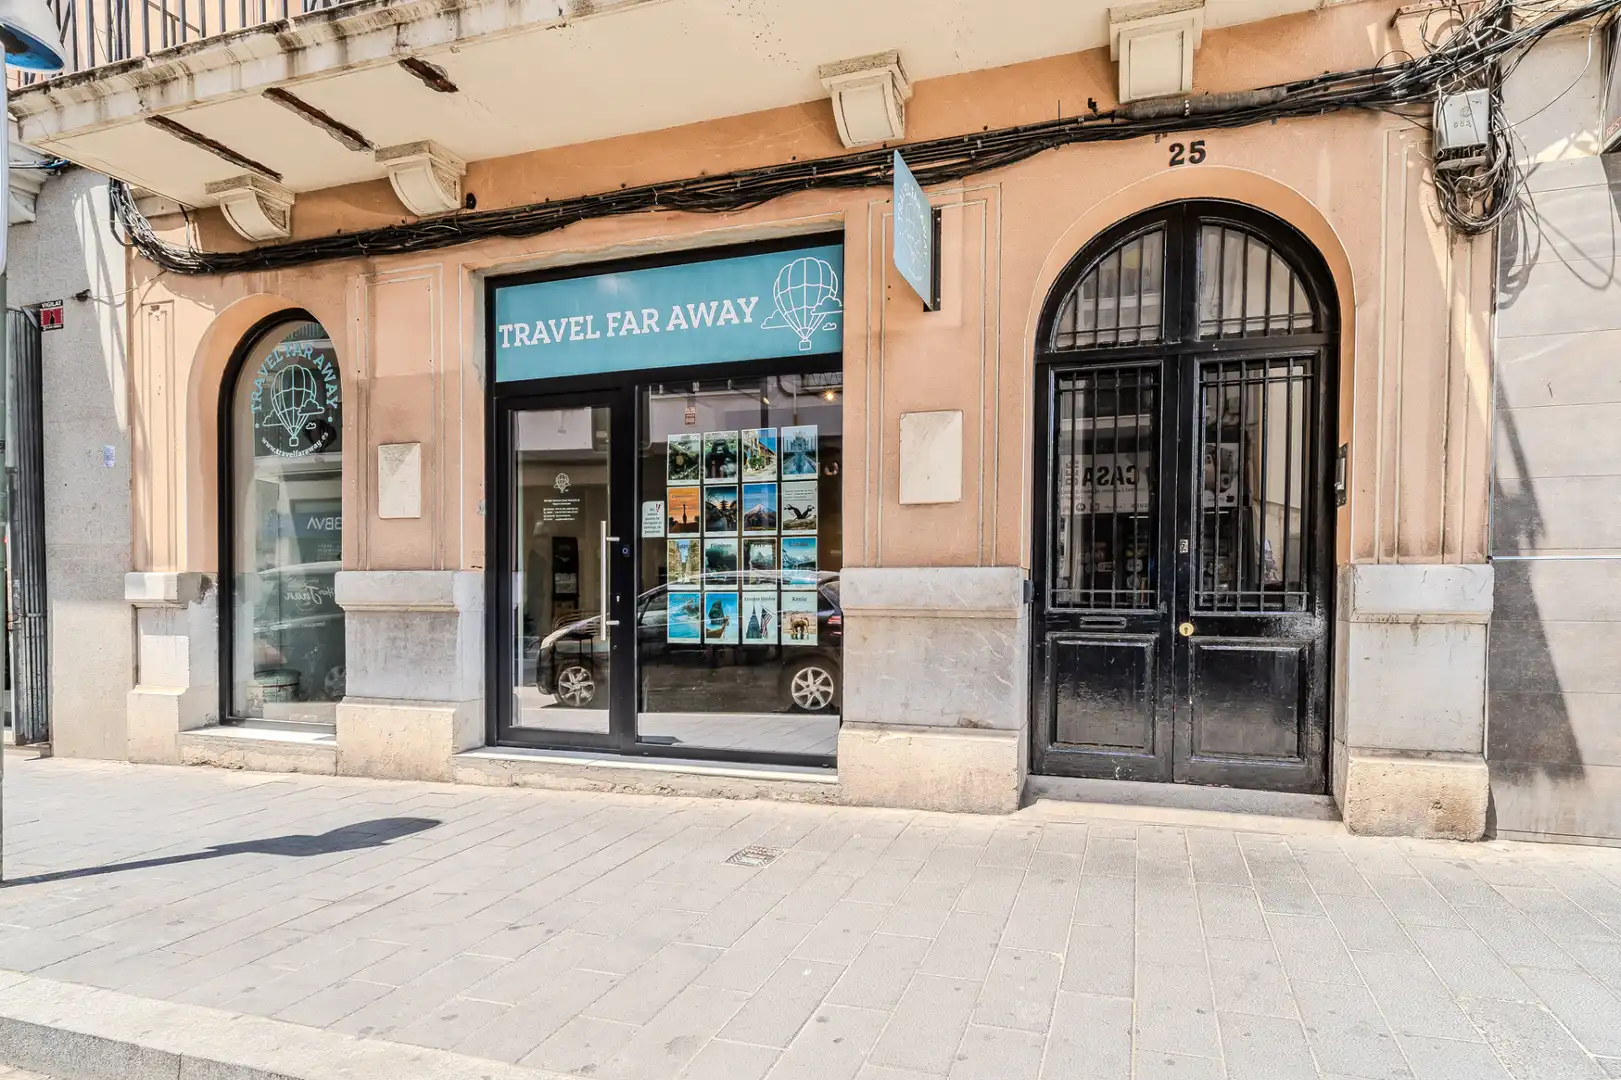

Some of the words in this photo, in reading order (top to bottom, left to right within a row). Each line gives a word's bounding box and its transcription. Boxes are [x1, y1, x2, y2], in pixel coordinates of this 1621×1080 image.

[1169, 140, 1206, 167] 25
[499, 315, 600, 348] TRAVEL
[606, 308, 660, 337] FAR
[666, 296, 759, 331] AWAY
[251, 349, 285, 413] TRAVEL
[285, 342, 314, 360] FAR
[313, 353, 339, 410] AWAY
